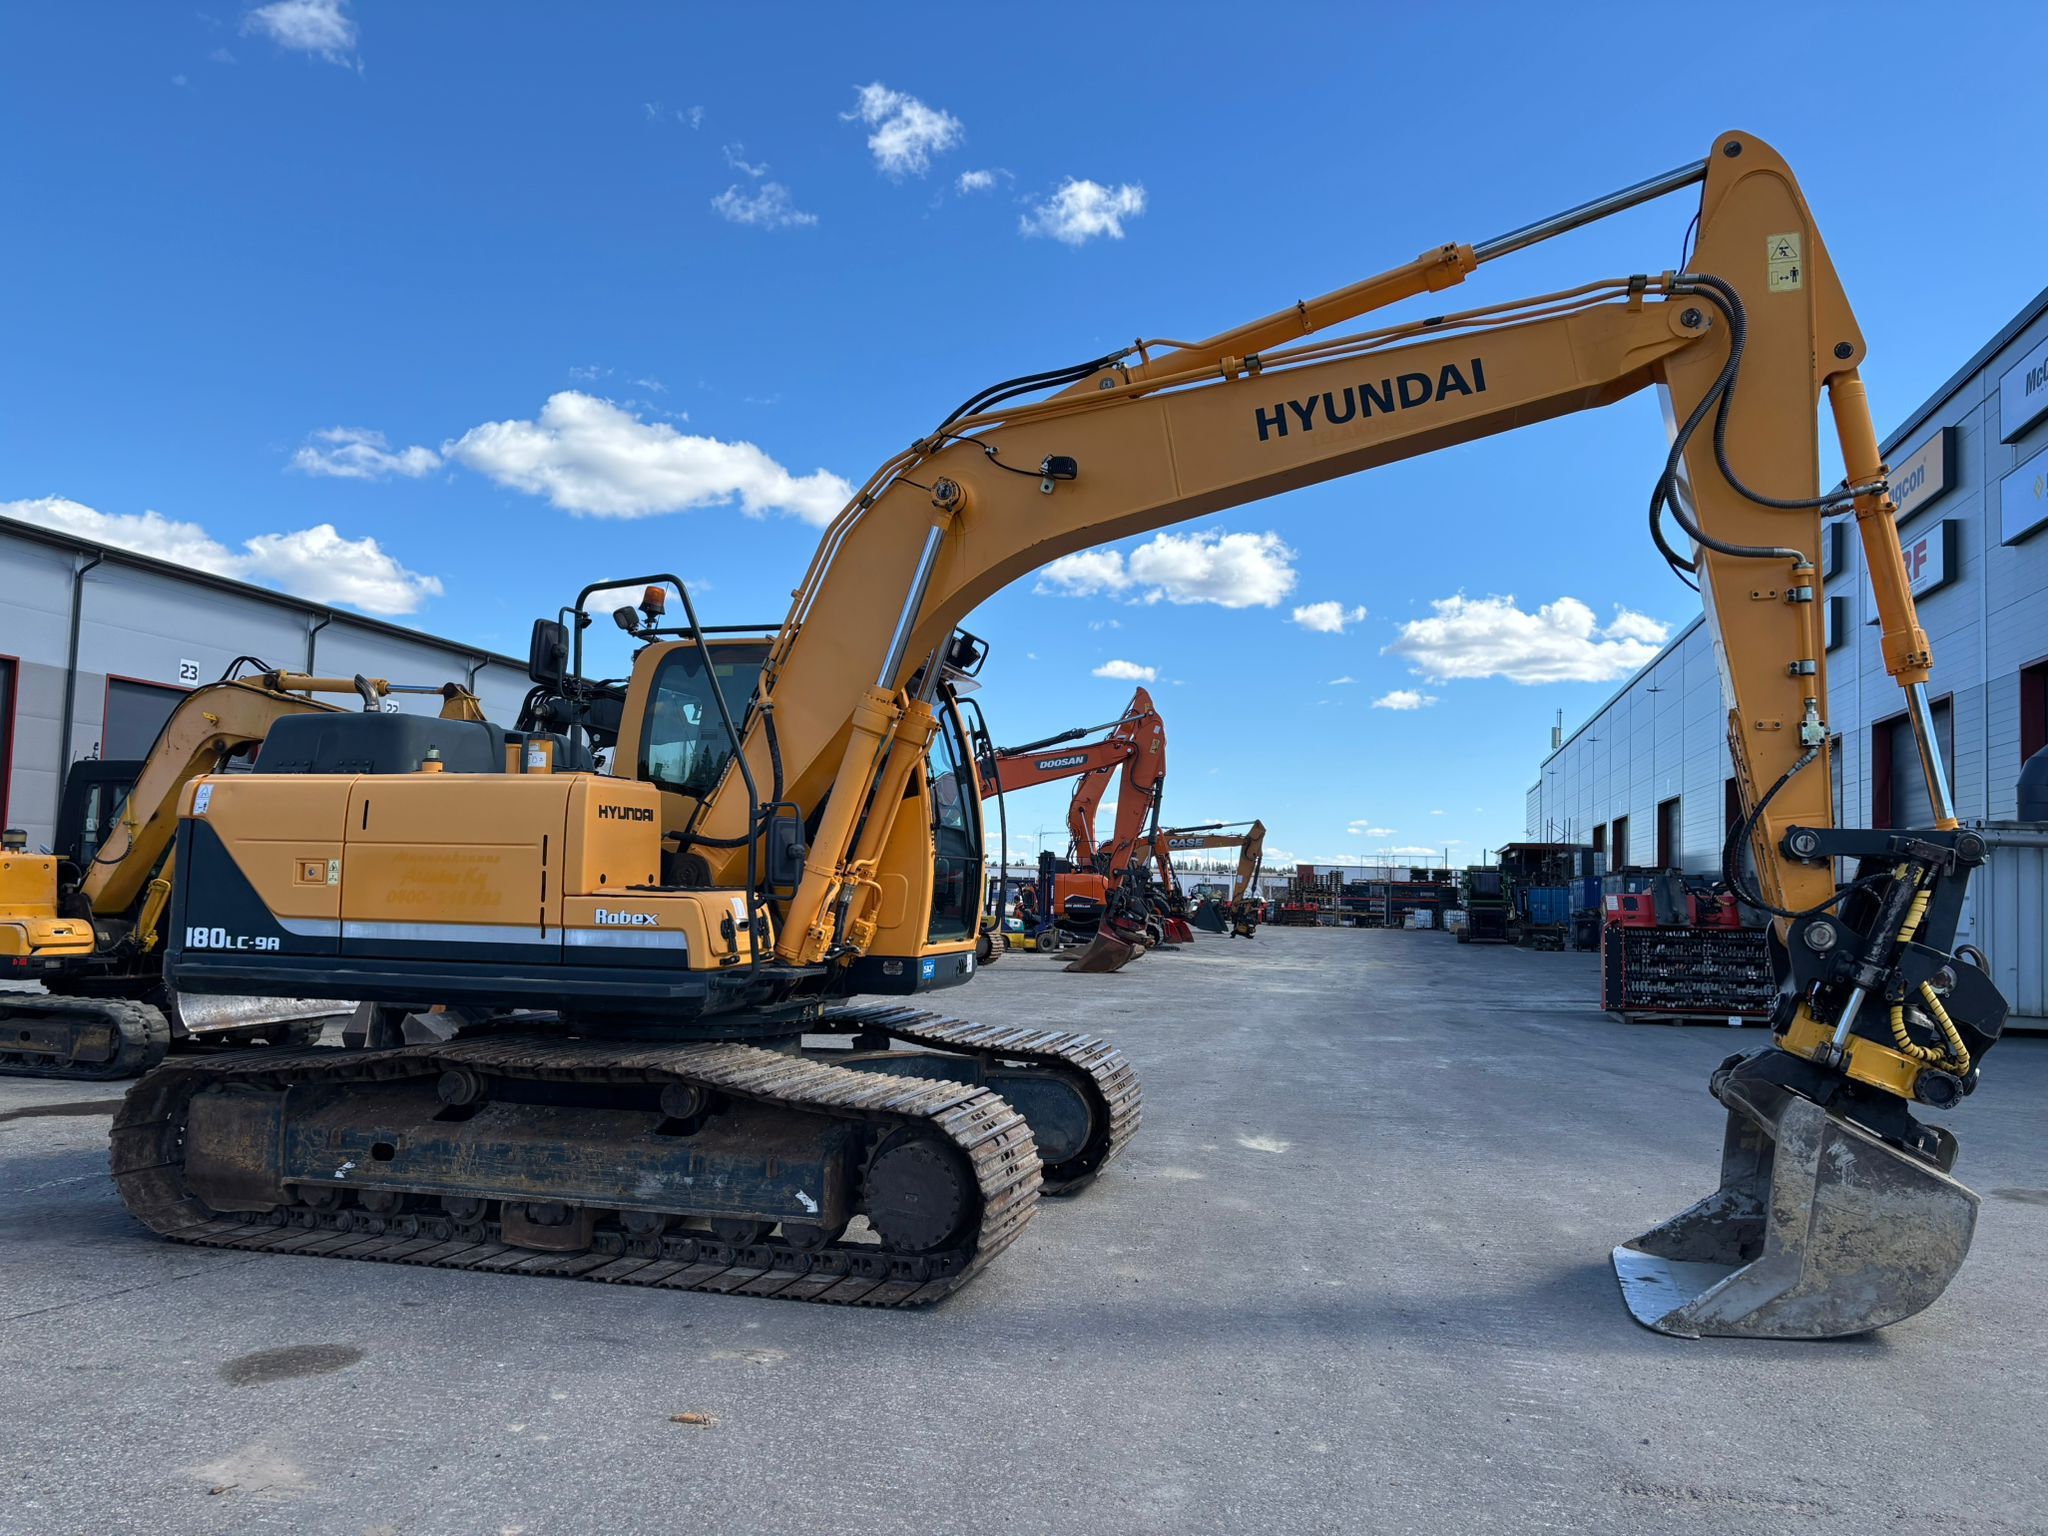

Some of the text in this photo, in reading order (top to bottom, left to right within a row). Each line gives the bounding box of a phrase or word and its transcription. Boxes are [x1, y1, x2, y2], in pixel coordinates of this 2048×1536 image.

[1255, 358, 1487, 442] HYUNDAI
[180, 663, 198, 680] 23
[1039, 756, 1084, 769] DOOSAN
[598, 804, 654, 822] HYUNDAI
[1168, 838, 1205, 849] CASE
[594, 908, 659, 926] Robex
